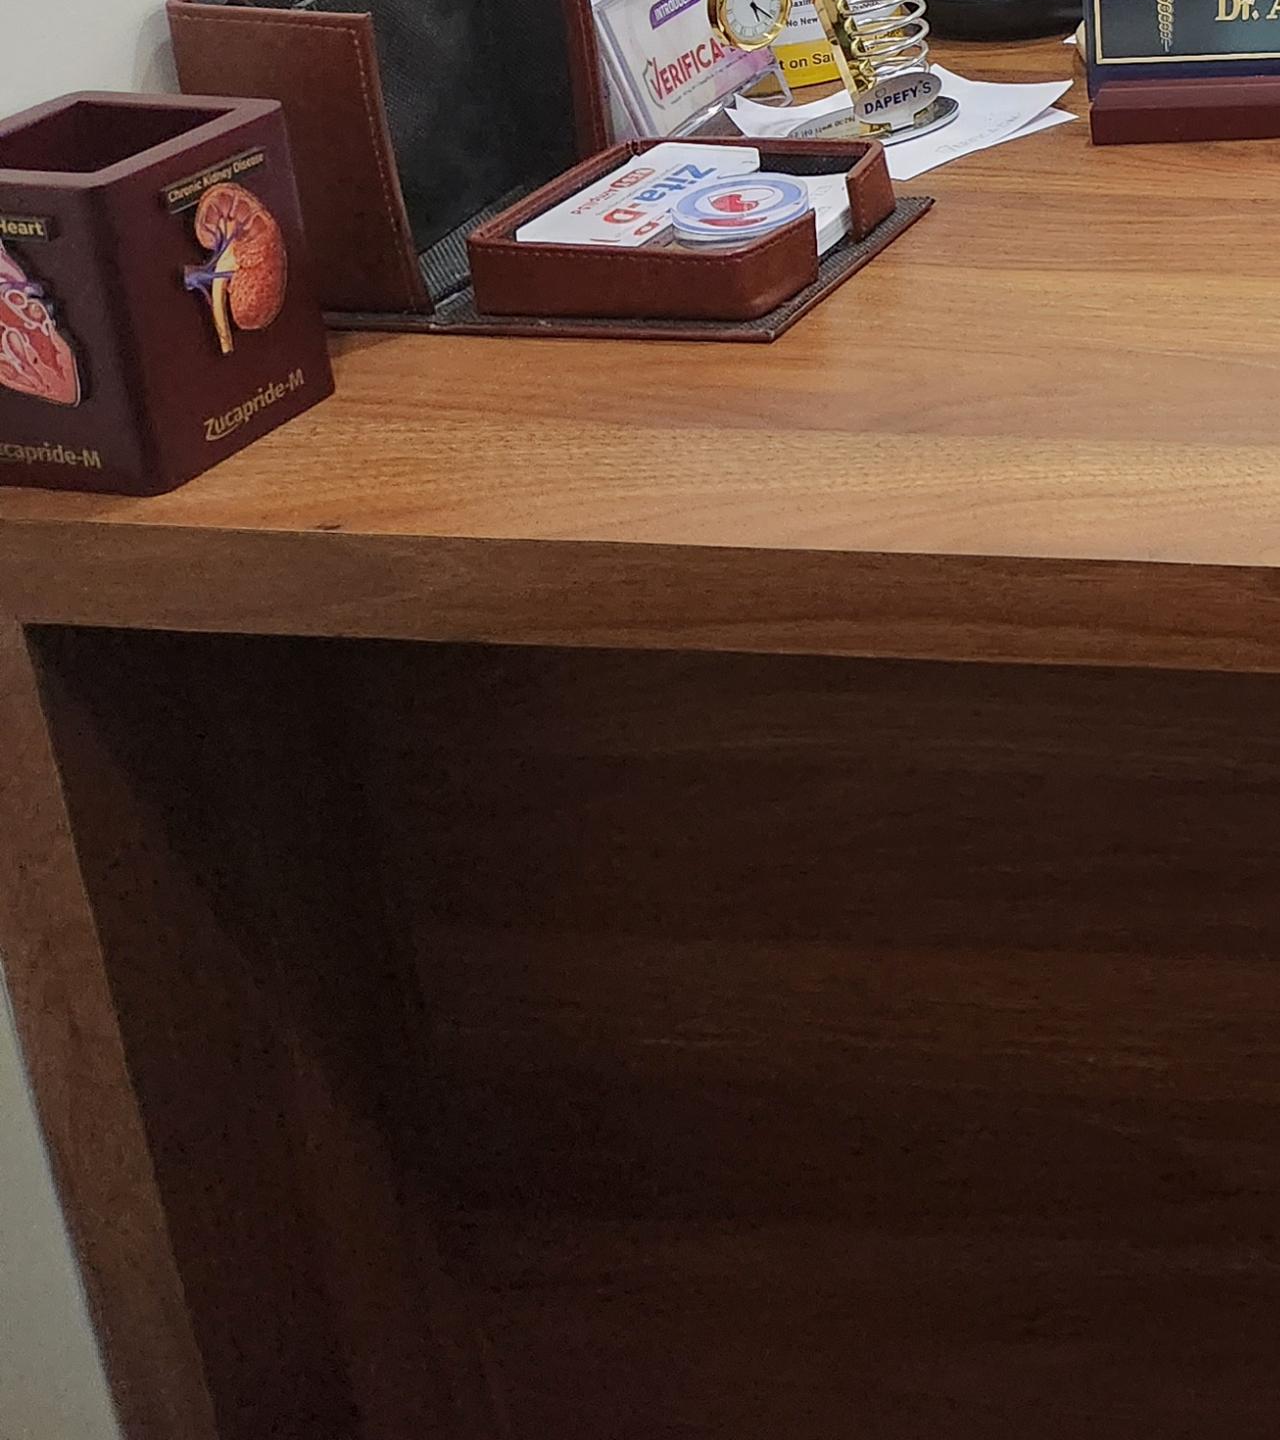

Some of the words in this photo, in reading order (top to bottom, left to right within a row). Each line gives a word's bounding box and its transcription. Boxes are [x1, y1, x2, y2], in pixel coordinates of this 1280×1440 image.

[801, 17, 818, 26] New
[650, 37, 736, 100] VERIFICA
[790, 58, 808, 68] on
[864, 80, 932, 115] DAPEFY'S
[167, 179, 203, 204] Chronic
[203, 167, 233, 189] Kidney
[233, 153, 264, 174] Disease
[204, 368, 305, 442] Zucapride-M
